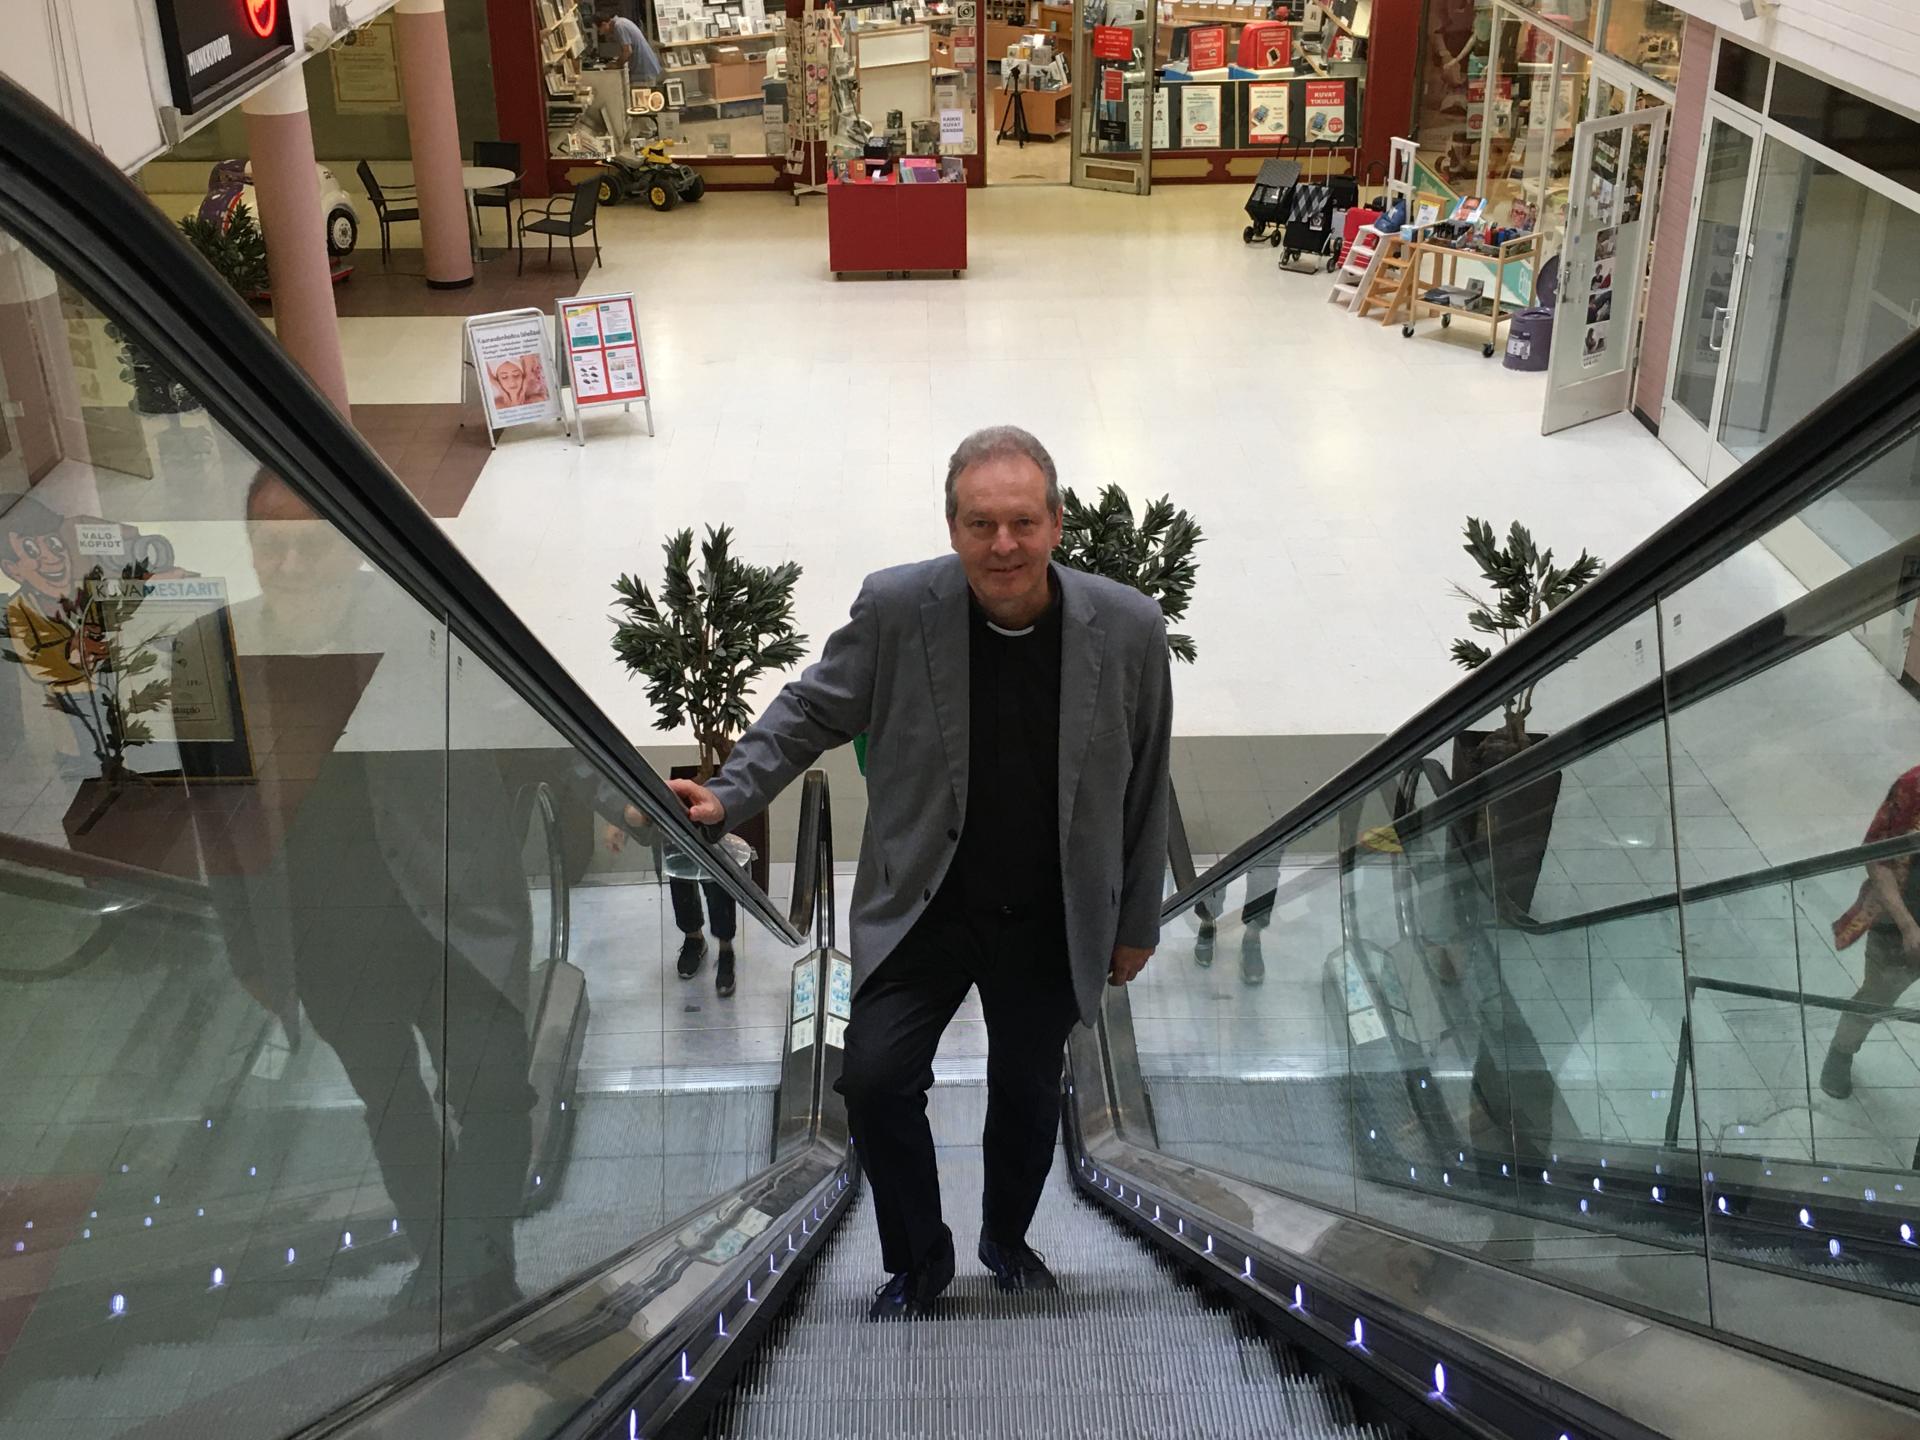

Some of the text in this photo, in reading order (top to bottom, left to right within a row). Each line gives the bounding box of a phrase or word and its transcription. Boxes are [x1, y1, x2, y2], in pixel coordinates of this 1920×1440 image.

[82, 532, 116, 540] VALO-
[79, 540, 121, 548] KOPIOT
[95, 582, 221, 597] KUVAMESTARIT
